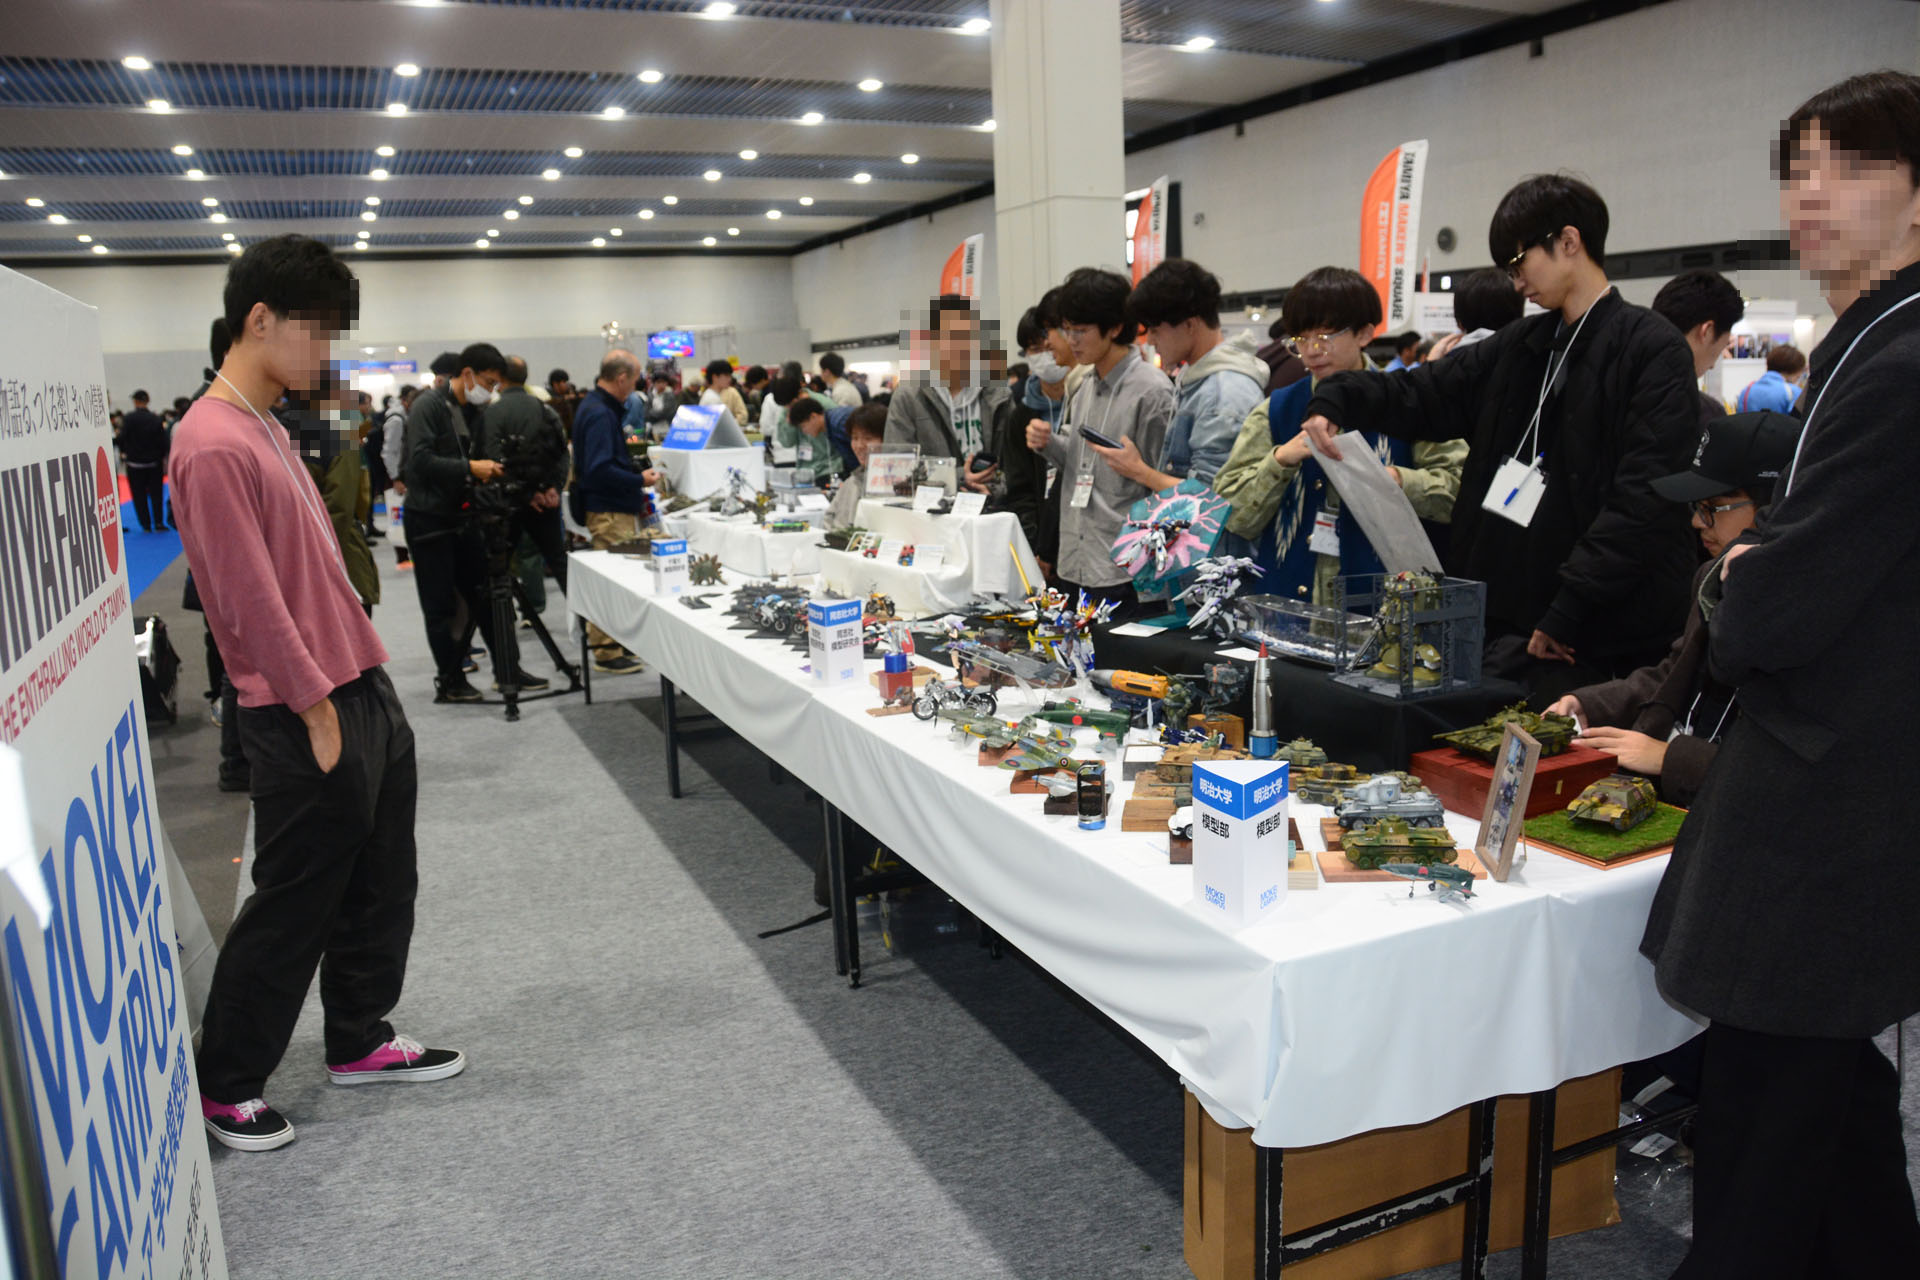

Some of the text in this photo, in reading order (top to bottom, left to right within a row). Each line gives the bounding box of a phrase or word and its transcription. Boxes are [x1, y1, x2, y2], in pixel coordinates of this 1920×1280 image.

[98, 493, 117, 529] 2025
[18, 633, 77, 728] ENTHRALLING
[74, 610, 101, 661] WORLD
[1200, 777, 1233, 805] 明治大学
[1253, 776, 1283, 805] 明治大学
[1202, 811, 1230, 839] 模型部
[1256, 811, 1281, 839] 模型部
